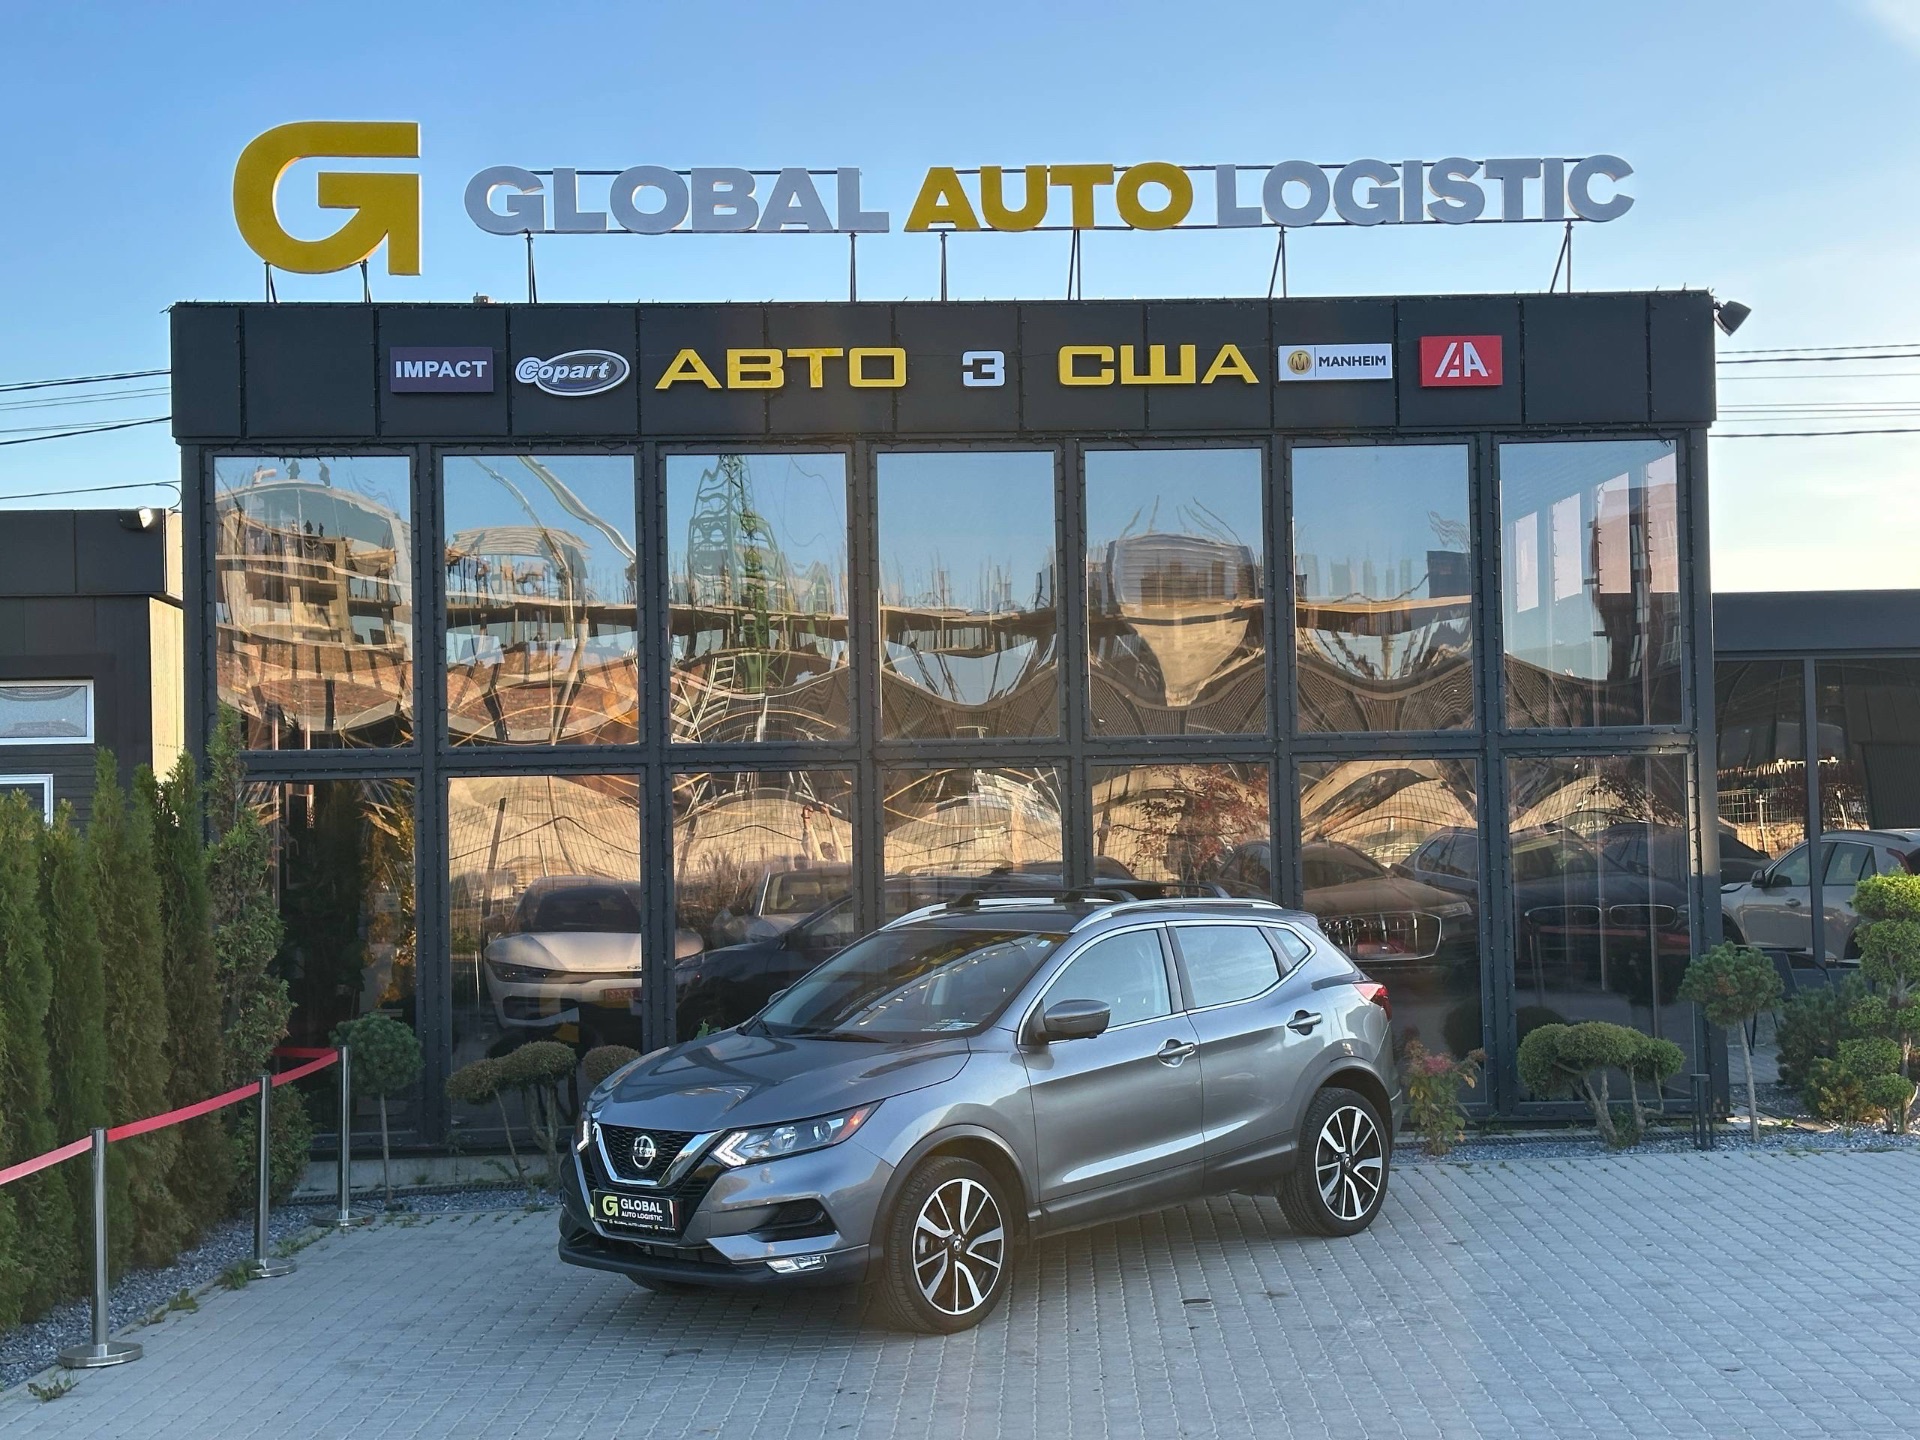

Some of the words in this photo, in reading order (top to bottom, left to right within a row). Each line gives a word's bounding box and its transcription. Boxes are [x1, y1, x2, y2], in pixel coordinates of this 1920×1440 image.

[464, 165, 889, 235] GLOBAL
[904, 162, 1193, 233] AUTO
[1215, 154, 1636, 228] LOGISTIC
[395, 360, 488, 379] IMPACT
[655, 346, 907, 391] АВТО
[1058, 344, 1260, 387] США
[1318, 355, 1387, 368] MANHEIM
[518, 360, 611, 385] Copart
[620, 1198, 663, 1214] GLOBAL
[621, 1210, 637, 1219] AUTO
[637, 1212, 663, 1222] LOGISTIC
